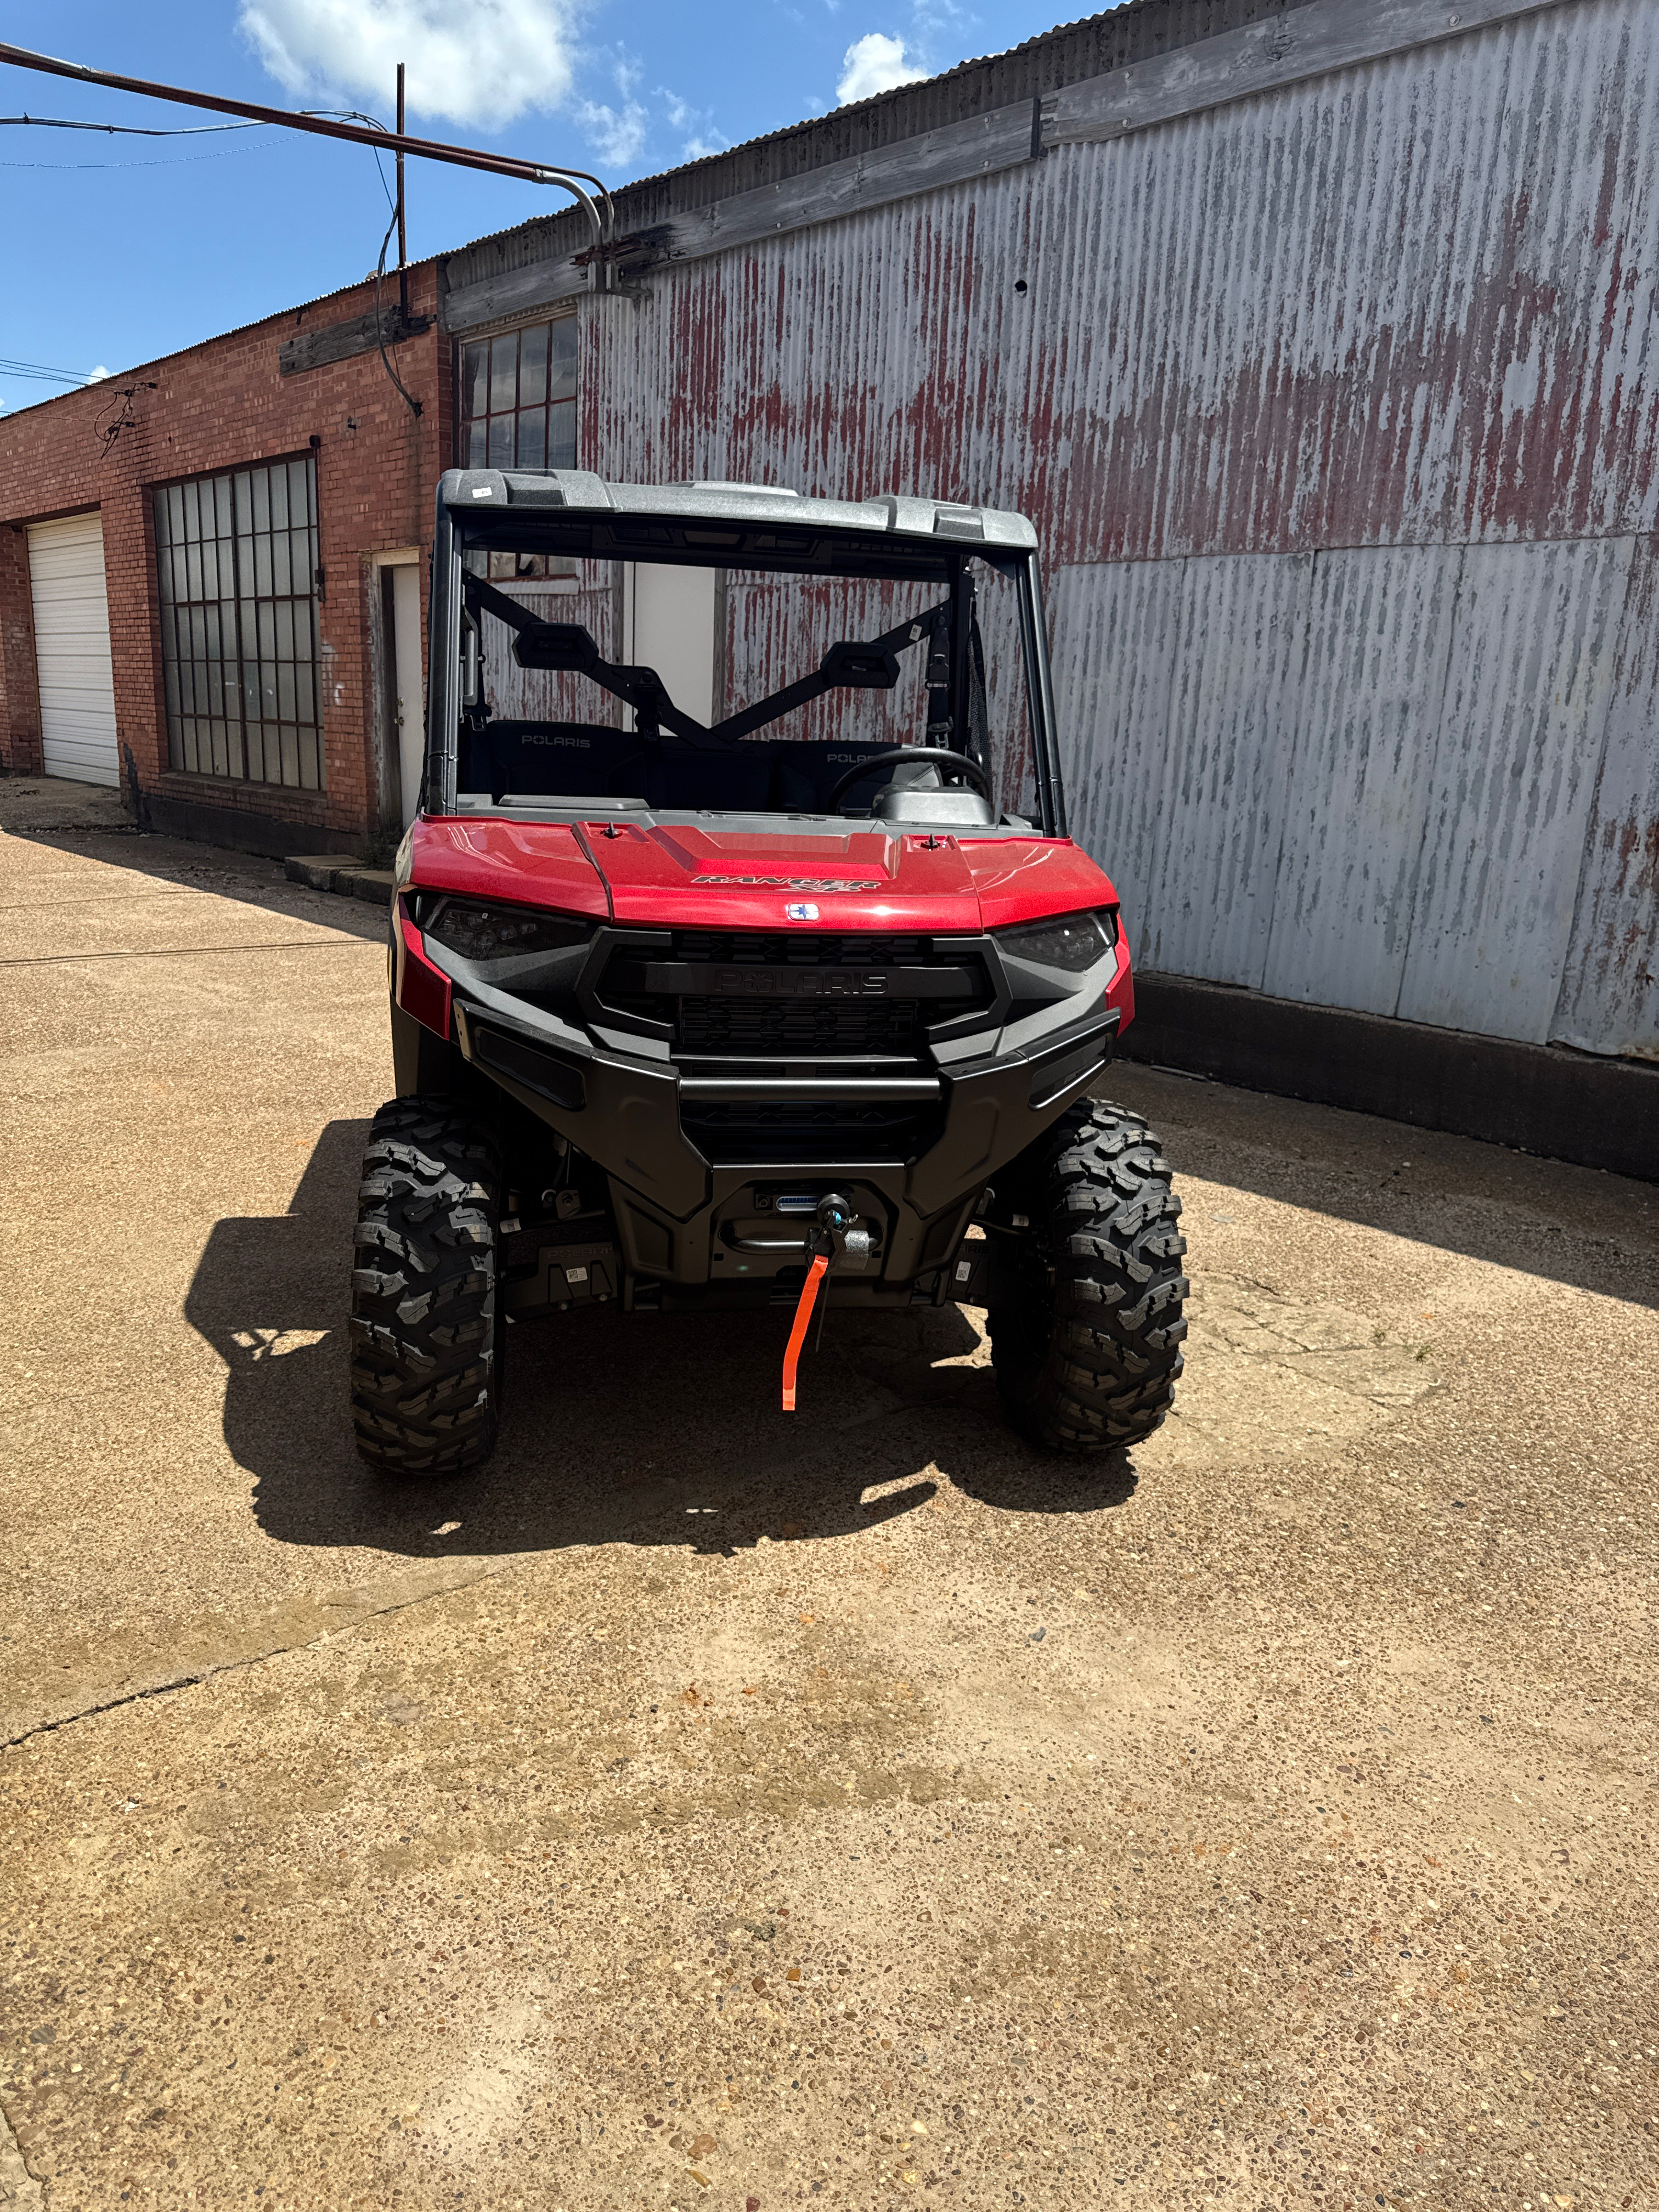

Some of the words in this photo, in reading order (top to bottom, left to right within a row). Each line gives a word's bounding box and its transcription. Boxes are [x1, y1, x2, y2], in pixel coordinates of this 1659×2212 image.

[522, 735, 591, 748] POLARIS
[827, 753, 875, 764] POLA
[691, 876, 882, 889] RANGER
[715, 969, 889, 994] POLARIS
